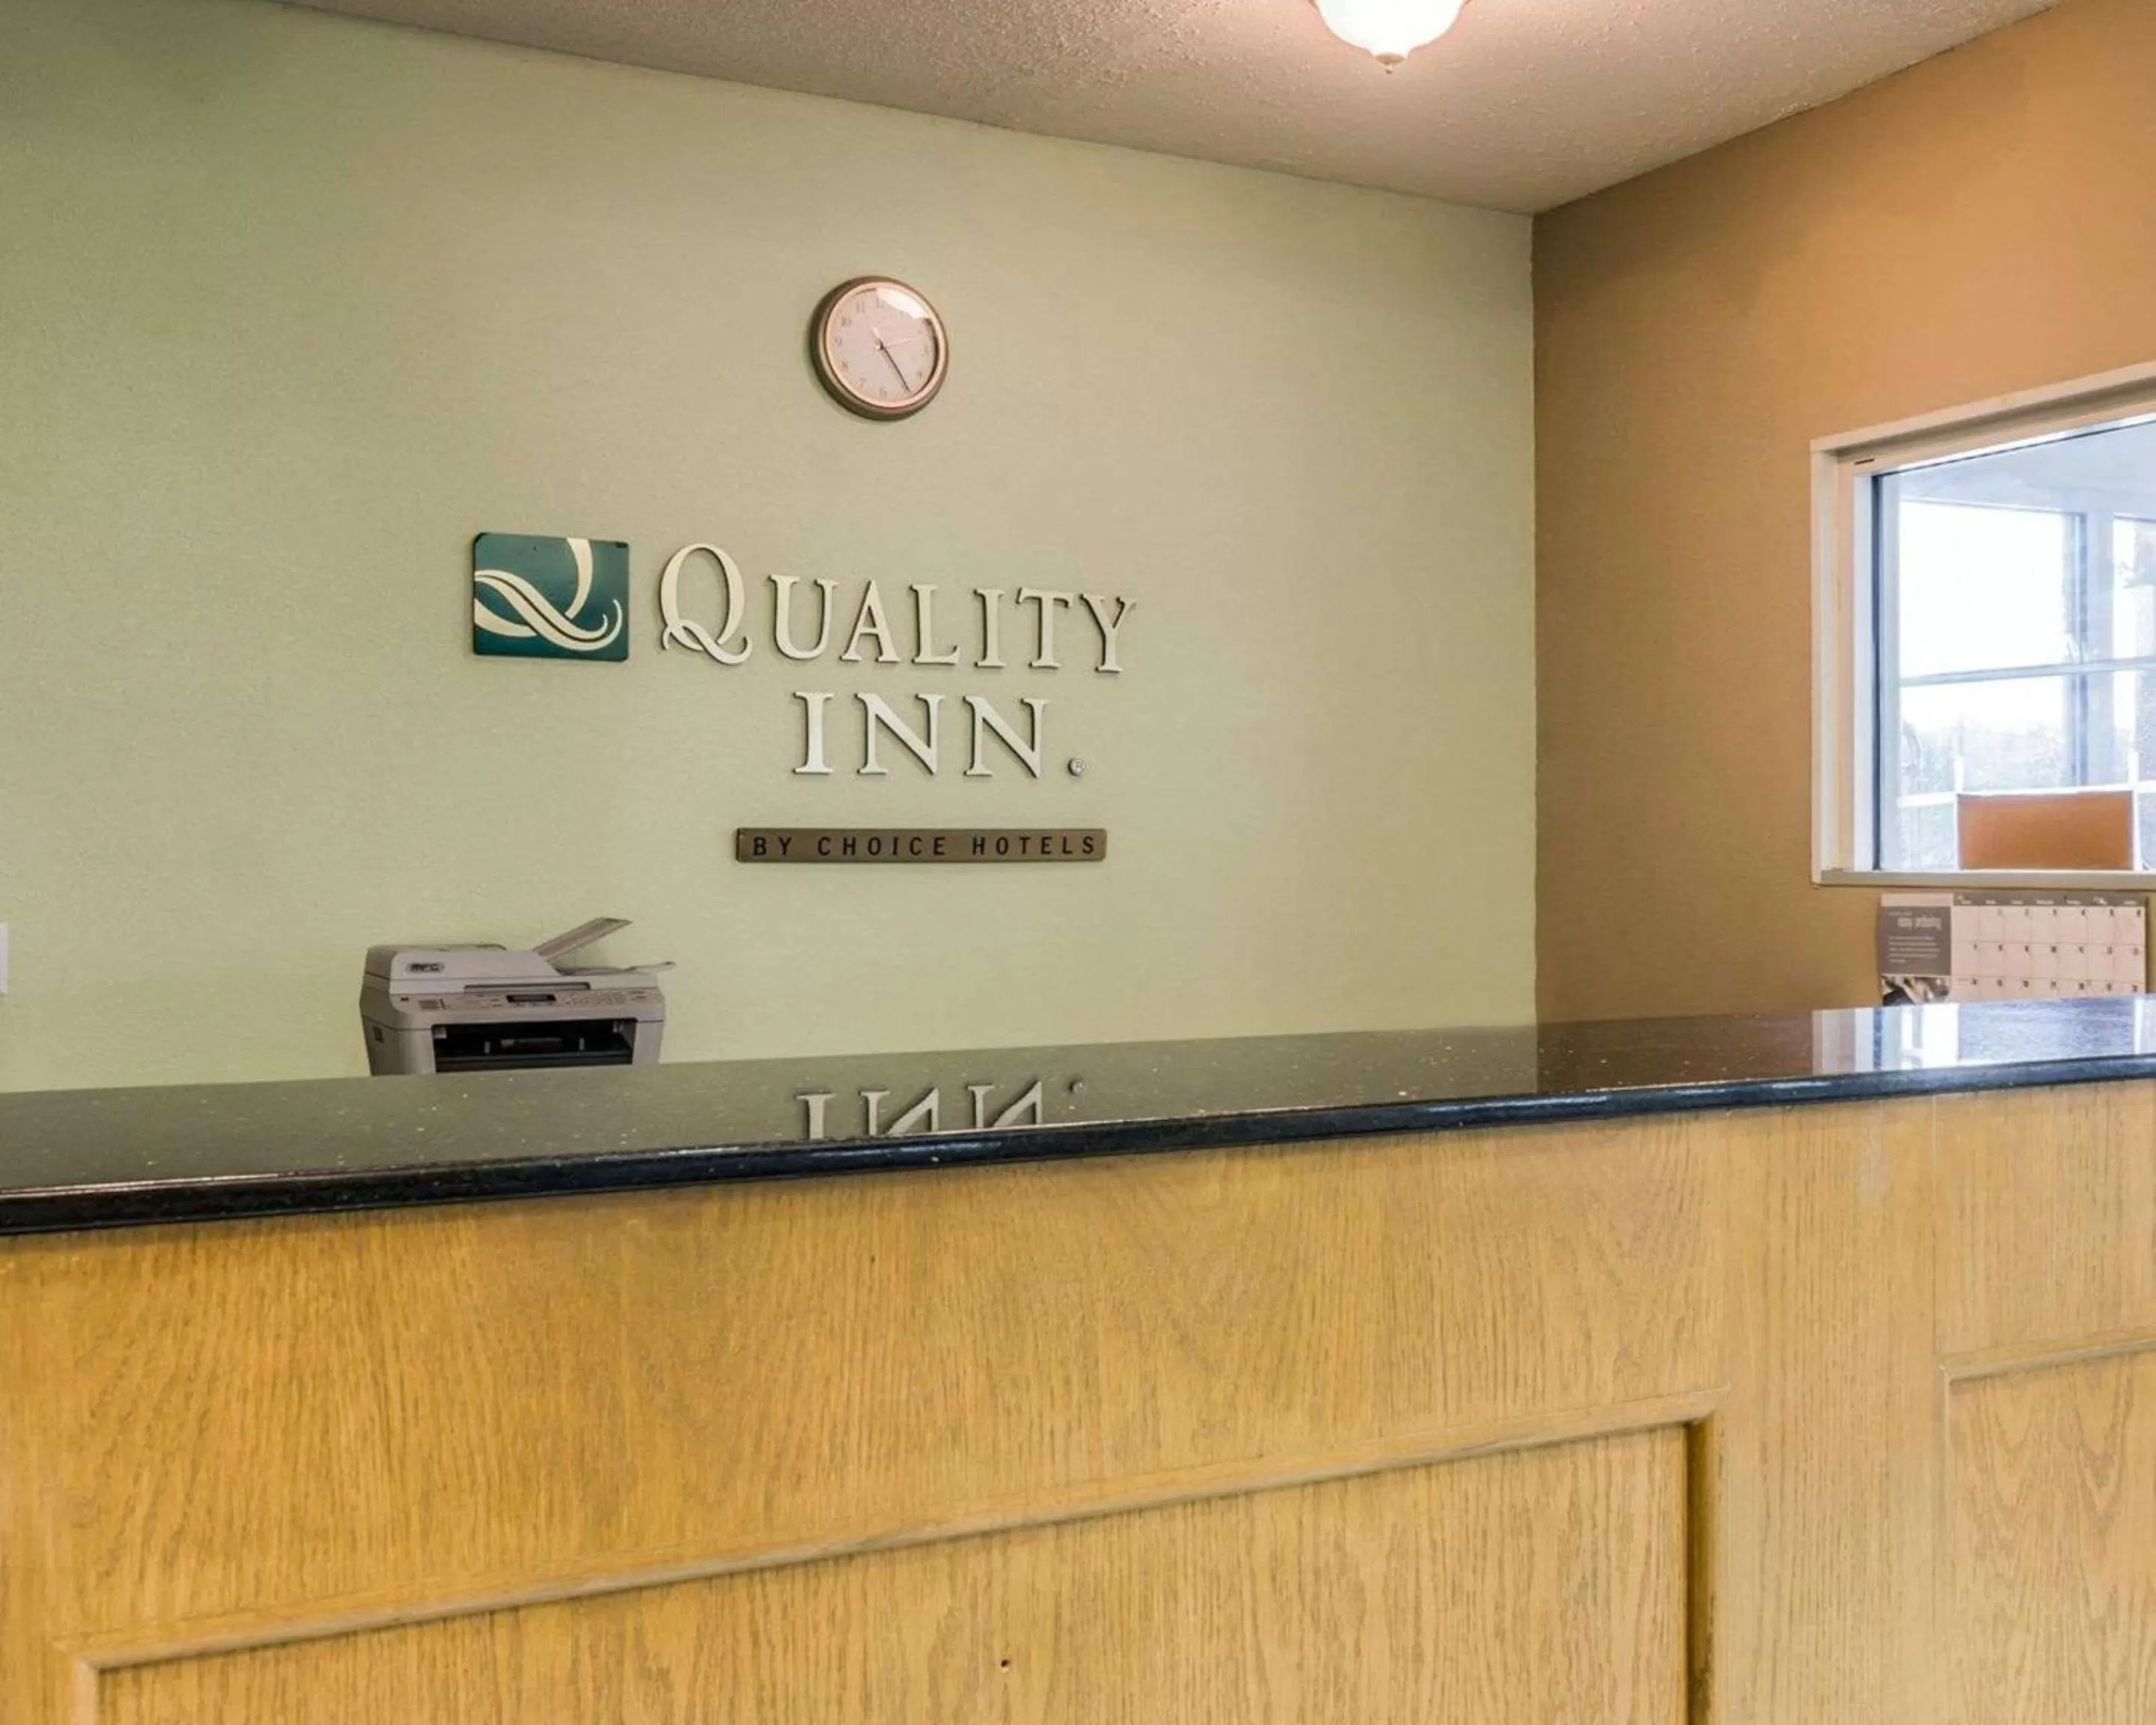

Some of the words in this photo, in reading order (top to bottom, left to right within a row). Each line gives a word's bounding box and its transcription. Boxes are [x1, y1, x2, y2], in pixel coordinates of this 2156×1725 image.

[660, 543, 1136, 673] QUALITY
[752, 836, 793, 856] BY
[817, 836, 946, 856] CHOICE
[973, 836, 1094, 856] HOTELS
